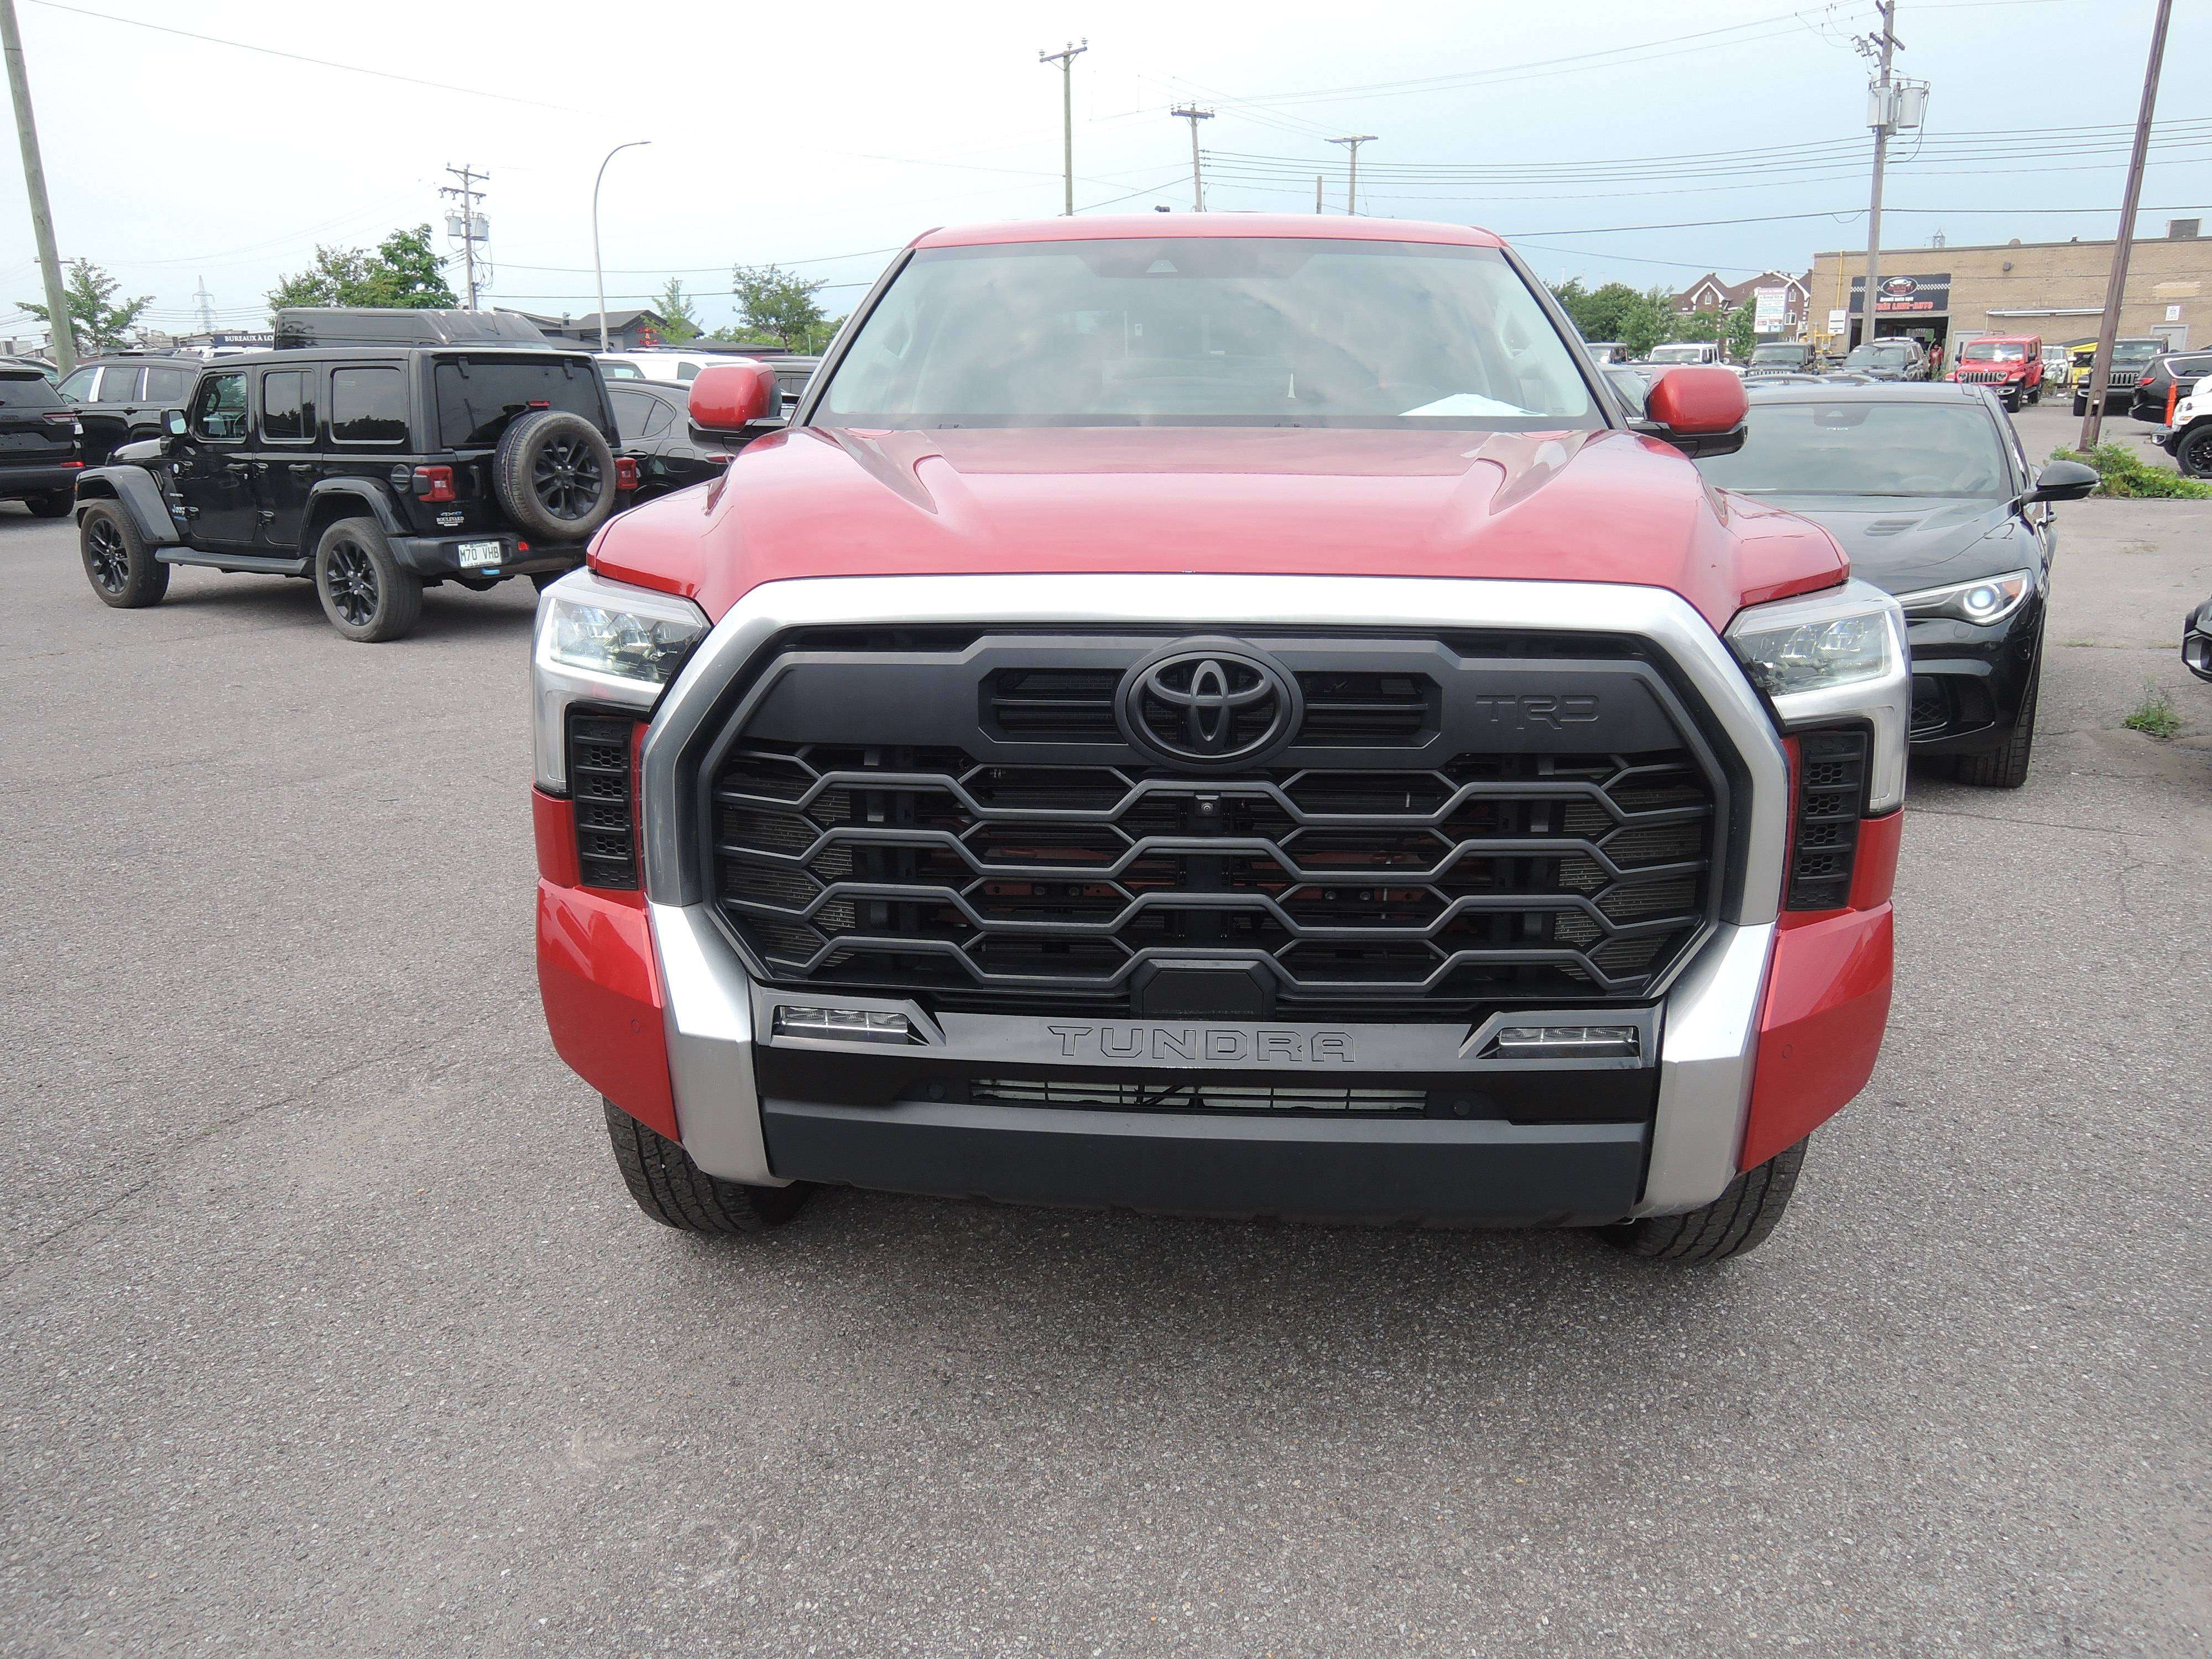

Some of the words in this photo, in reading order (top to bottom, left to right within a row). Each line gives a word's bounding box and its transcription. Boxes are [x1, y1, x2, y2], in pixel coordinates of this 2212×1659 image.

[482, 546, 499, 560] VHB
[1475, 695, 1599, 729] TRD
[1047, 1026, 1355, 1062] TUNDRA
